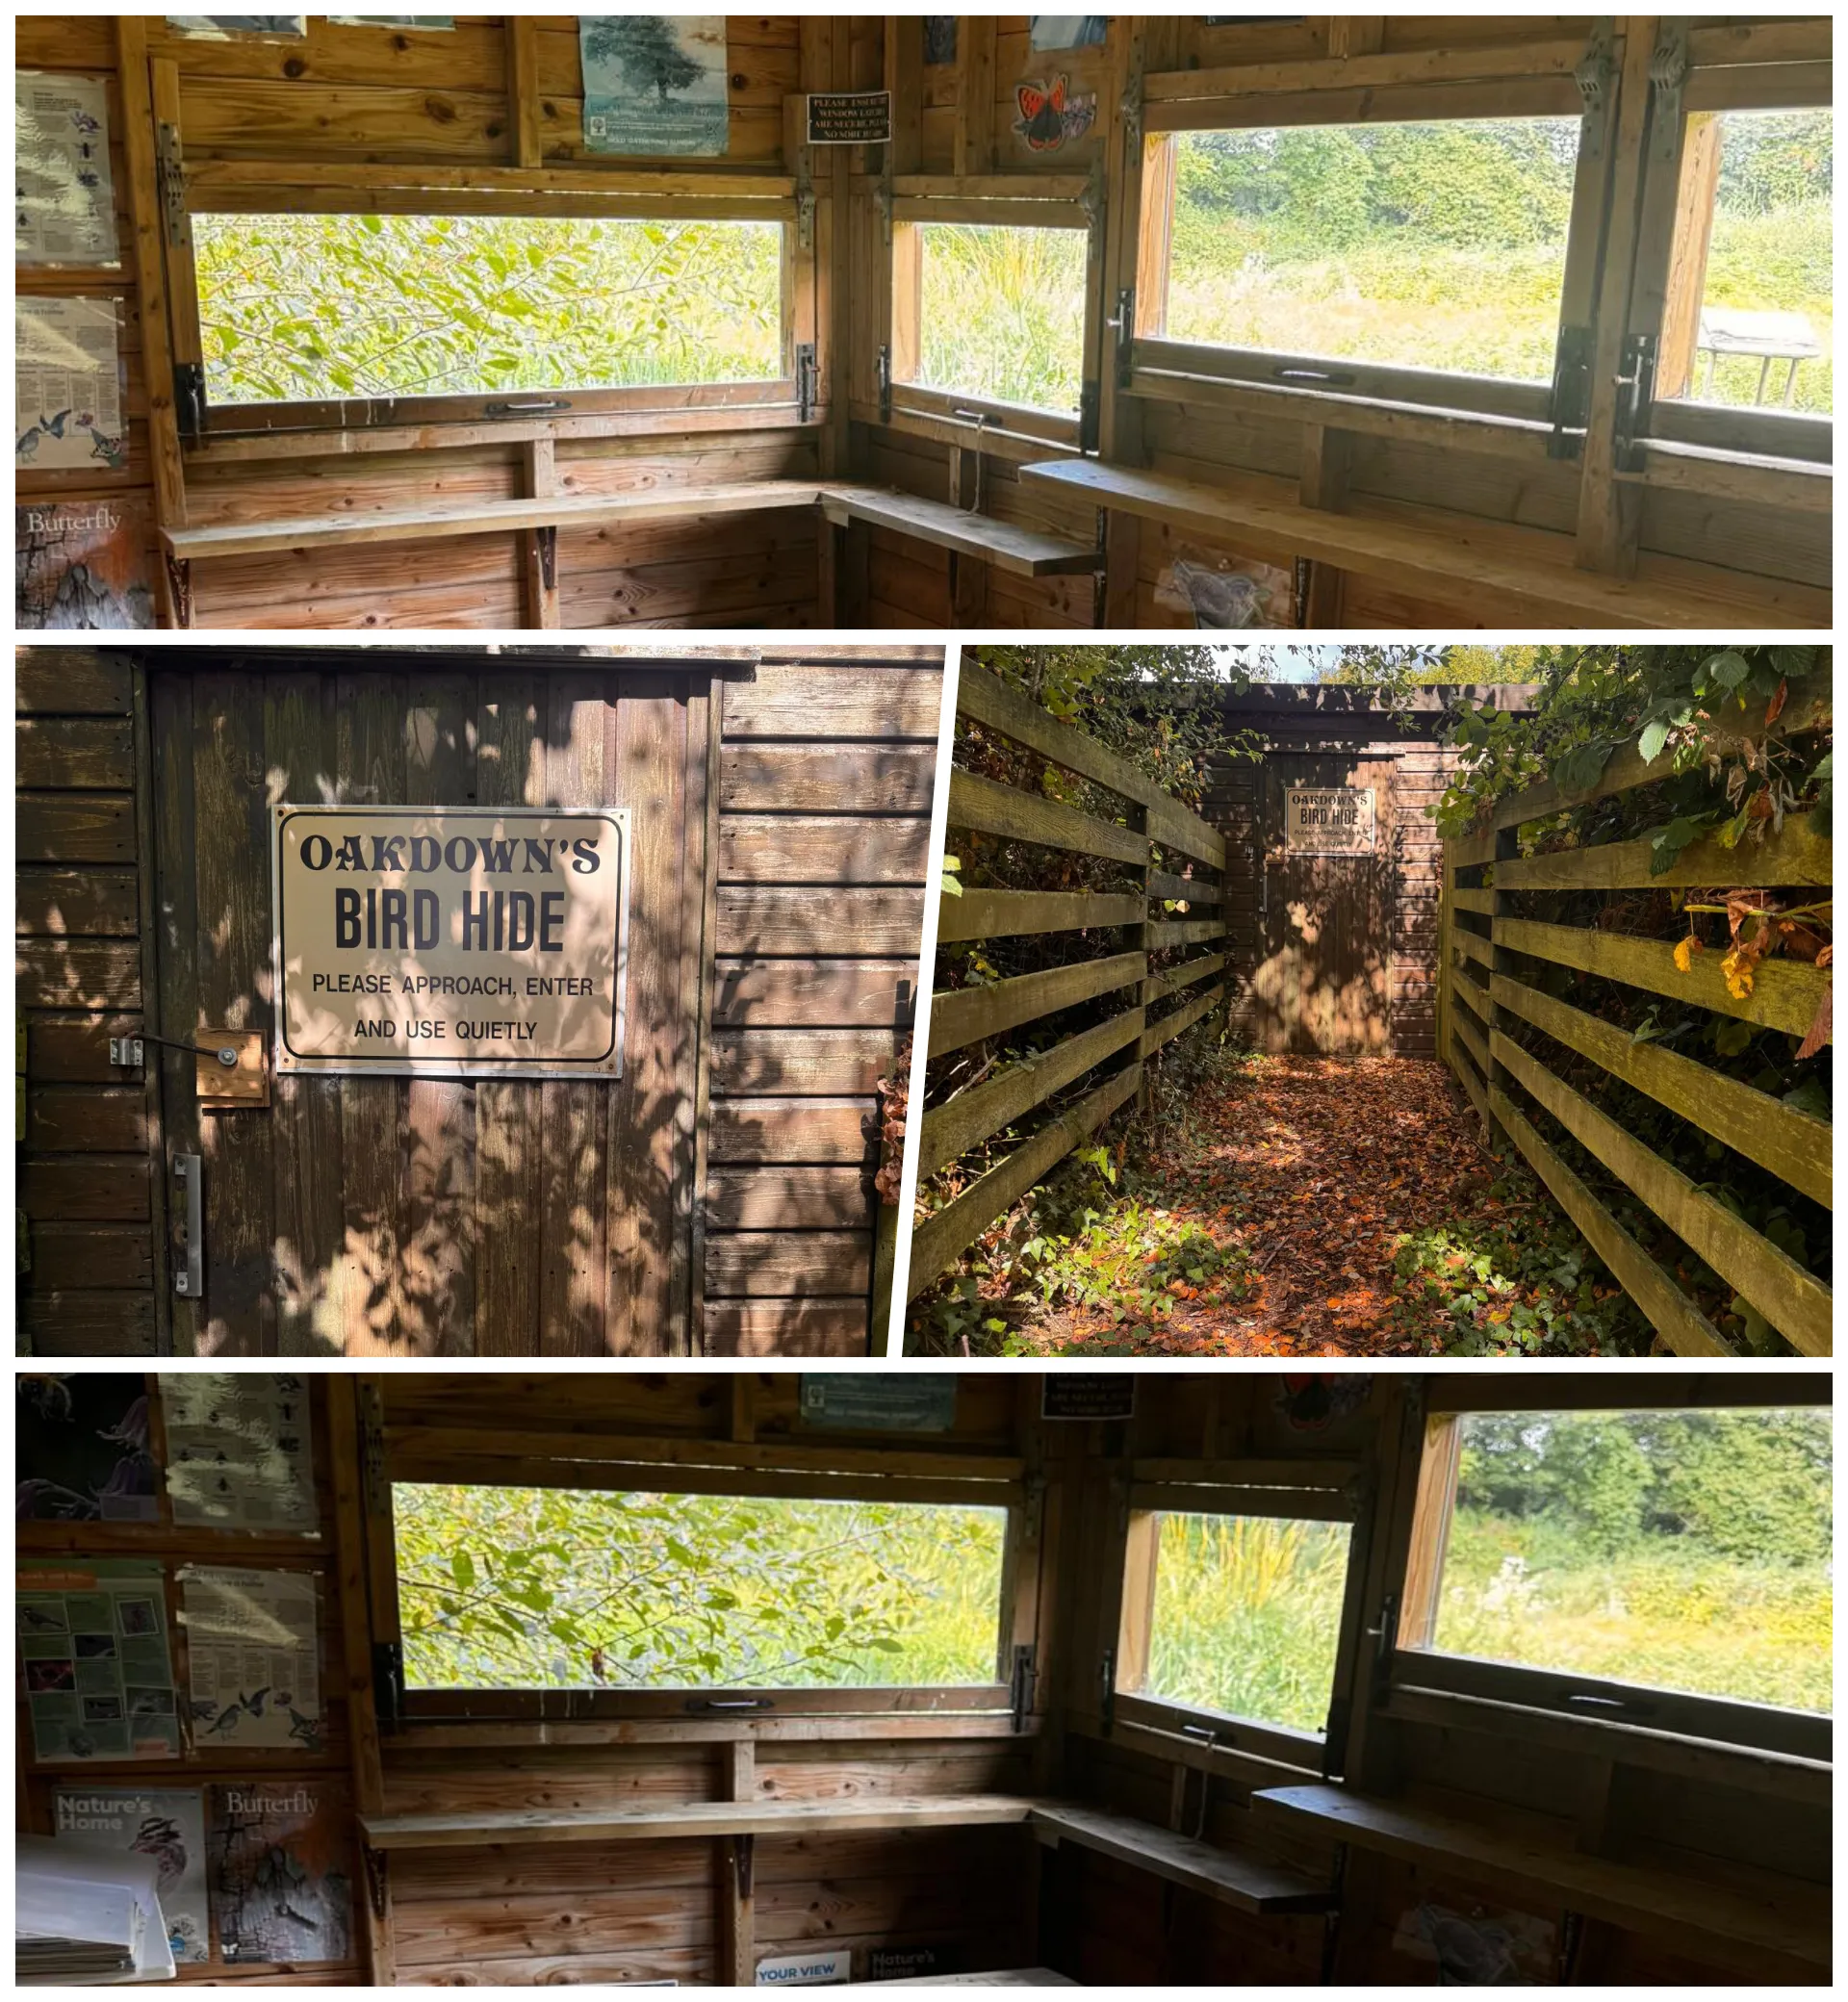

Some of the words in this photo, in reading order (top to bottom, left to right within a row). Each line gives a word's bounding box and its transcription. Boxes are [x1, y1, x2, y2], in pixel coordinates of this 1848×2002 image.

[814, 98, 847, 107] PLEASE
[28, 508, 122, 533] Butterfly
[1292, 794, 1368, 806] OAKDOWN'S
[1300, 808, 1327, 825] BIRD
[1332, 808, 1359, 825] HIDE
[299, 834, 602, 874] OAKDOWN'S
[336, 887, 440, 951] BIRD
[462, 890, 565, 952] HIDE
[313, 973, 392, 993] PLEASE
[401, 975, 517, 999] APPROACH,
[526, 977, 594, 996] ENTER
[354, 1020, 397, 1039] AND
[405, 1020, 446, 1039] USE
[455, 1021, 538, 1040] QUIETLY
[58, 1795, 152, 1814] Nature's
[227, 1790, 319, 1817] Butterfly
[59, 1814, 123, 1831] Home
[871, 1950, 936, 1968] Nature's
[758, 1965, 797, 1982] YOUR
[801, 1963, 835, 1978] VIEW
[871, 1965, 916, 1980] Home
